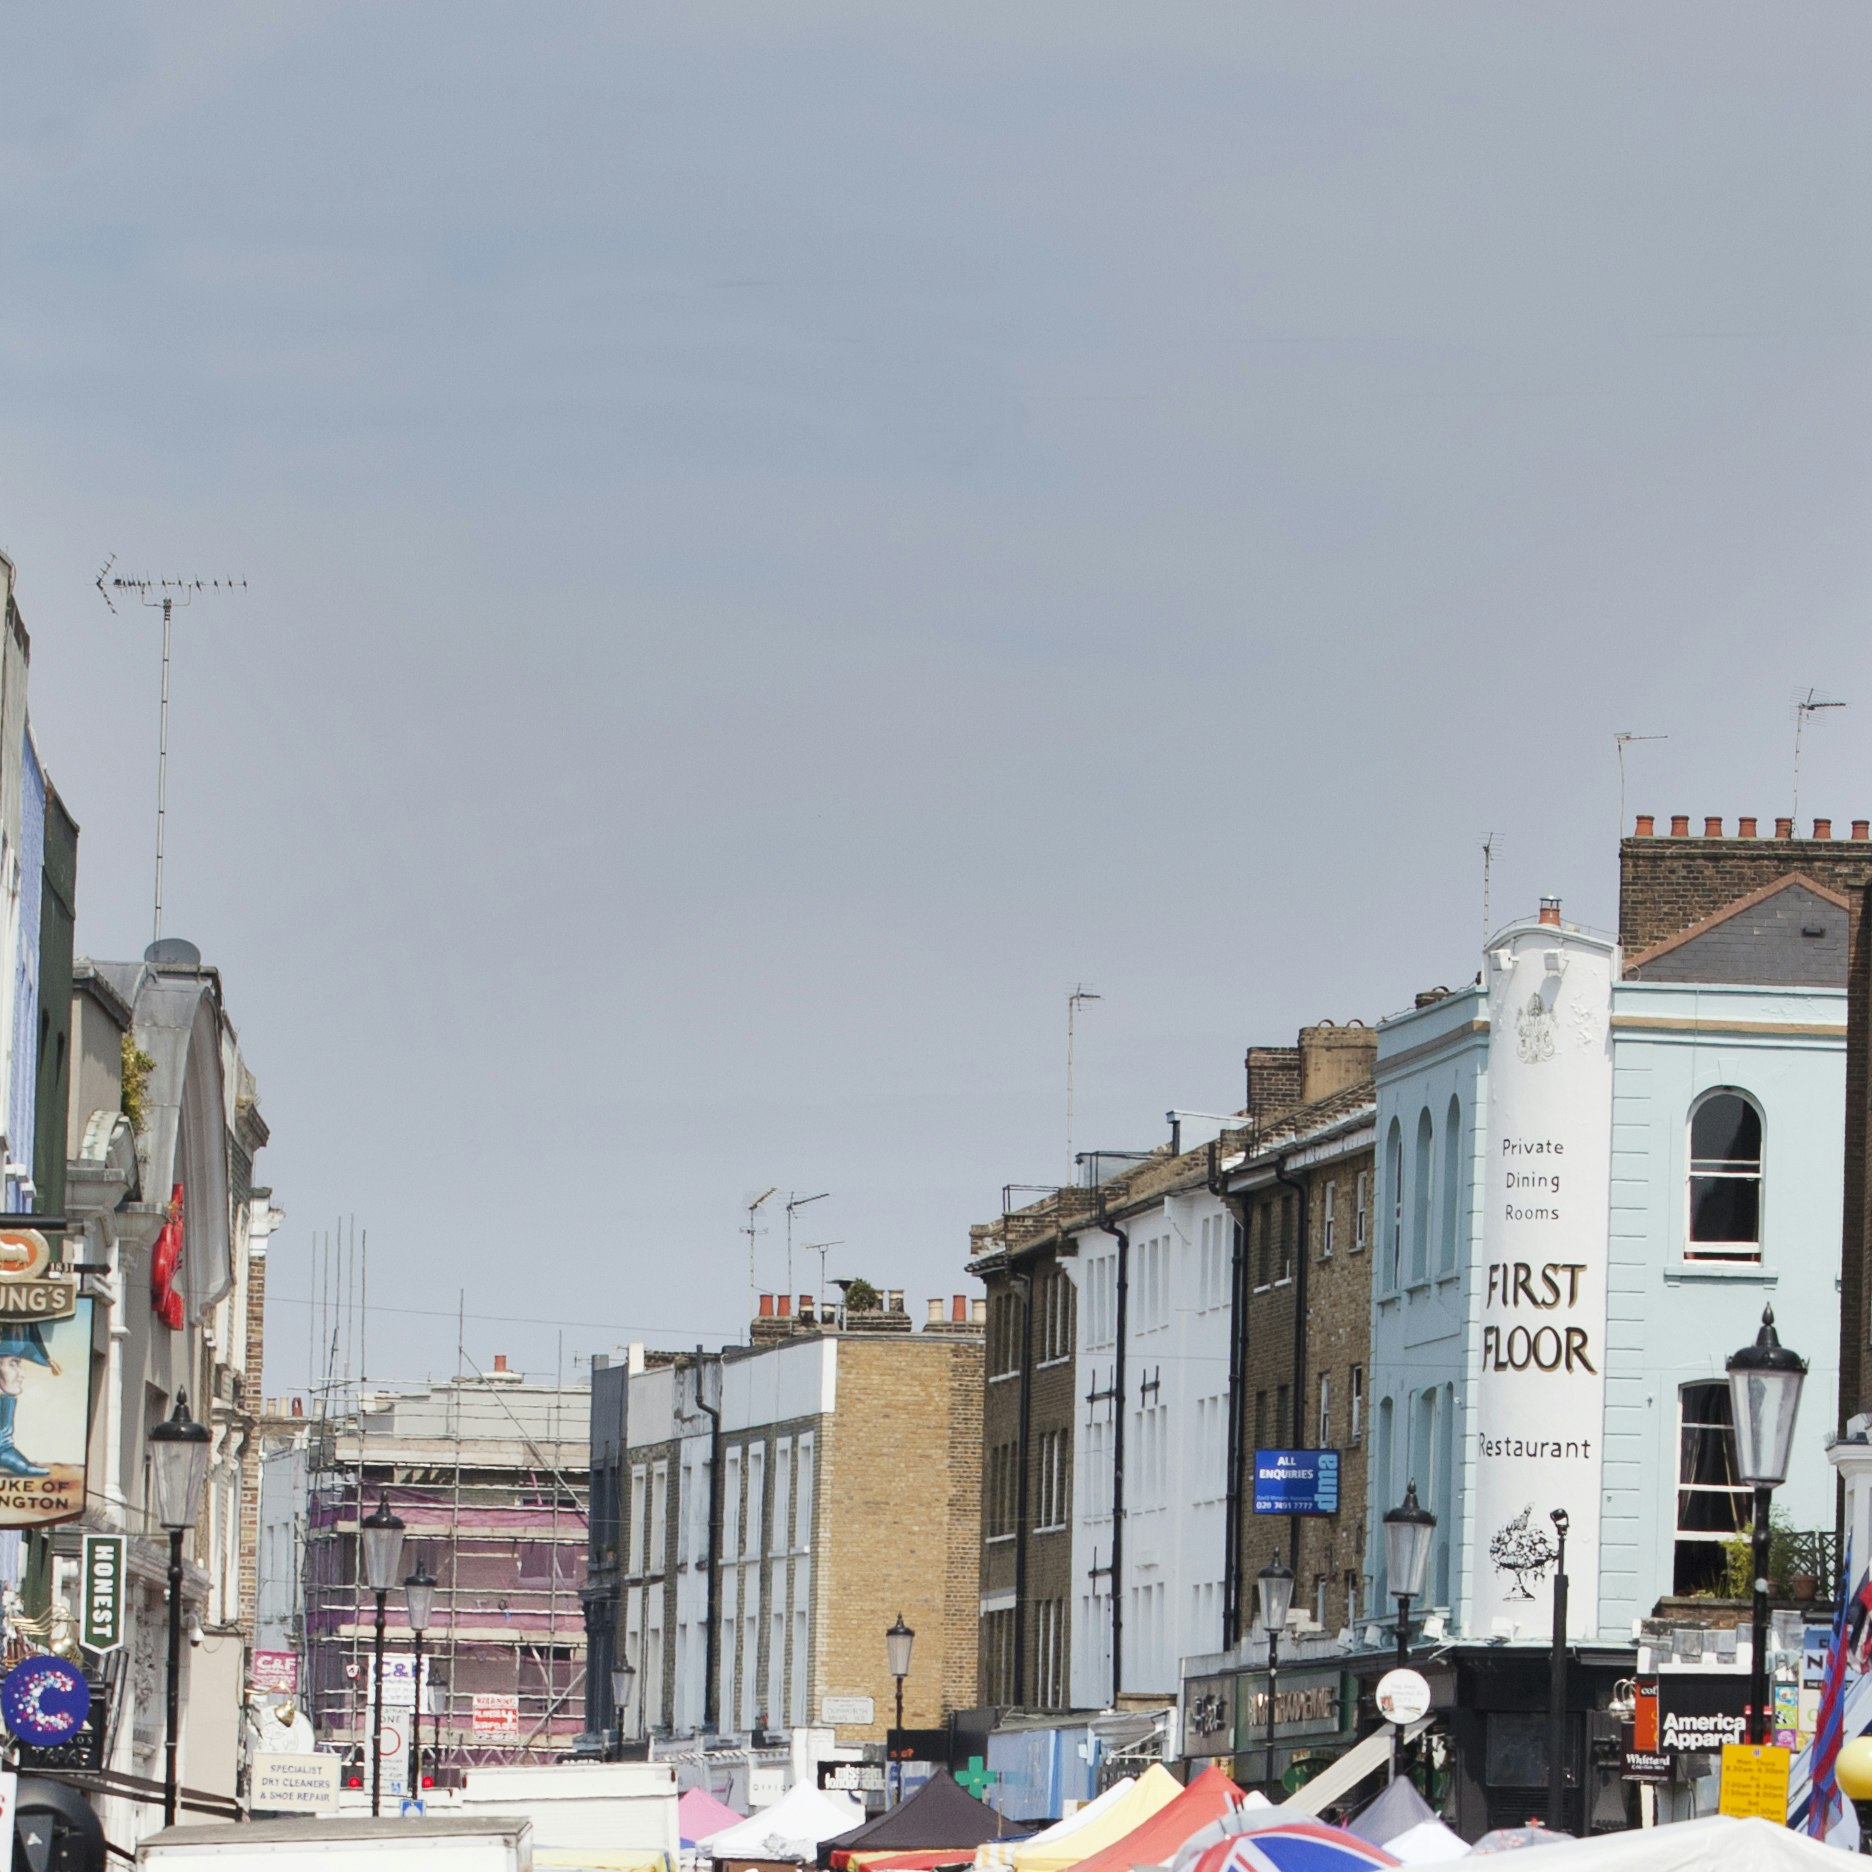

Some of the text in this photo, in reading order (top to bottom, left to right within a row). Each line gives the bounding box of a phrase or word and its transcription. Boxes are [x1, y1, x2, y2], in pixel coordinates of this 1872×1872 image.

[1502, 1138, 1564, 1155] Private
[1505, 1170, 1560, 1194] Dining
[1504, 1203, 1560, 1222] Rooms
[1487, 1262, 1588, 1311] FIRST
[1482, 1327, 1597, 1376] FLOOR
[1478, 1433, 1592, 1460] Restaurant
[1277, 1456, 1296, 1466] ALL
[1259, 1469, 1314, 1480] ENQUIRIES
[42, 1480, 69, 1494] OF
[91, 1545, 115, 1639] HONEST
[1663, 1713, 1746, 1730] America
[1663, 1729, 1740, 1750] Apparel
[270, 1765, 323, 1774] SPECIALIST
[262, 1778, 330, 1789] DRY CLEANERS
[297, 1793, 330, 1802] REPAIR
